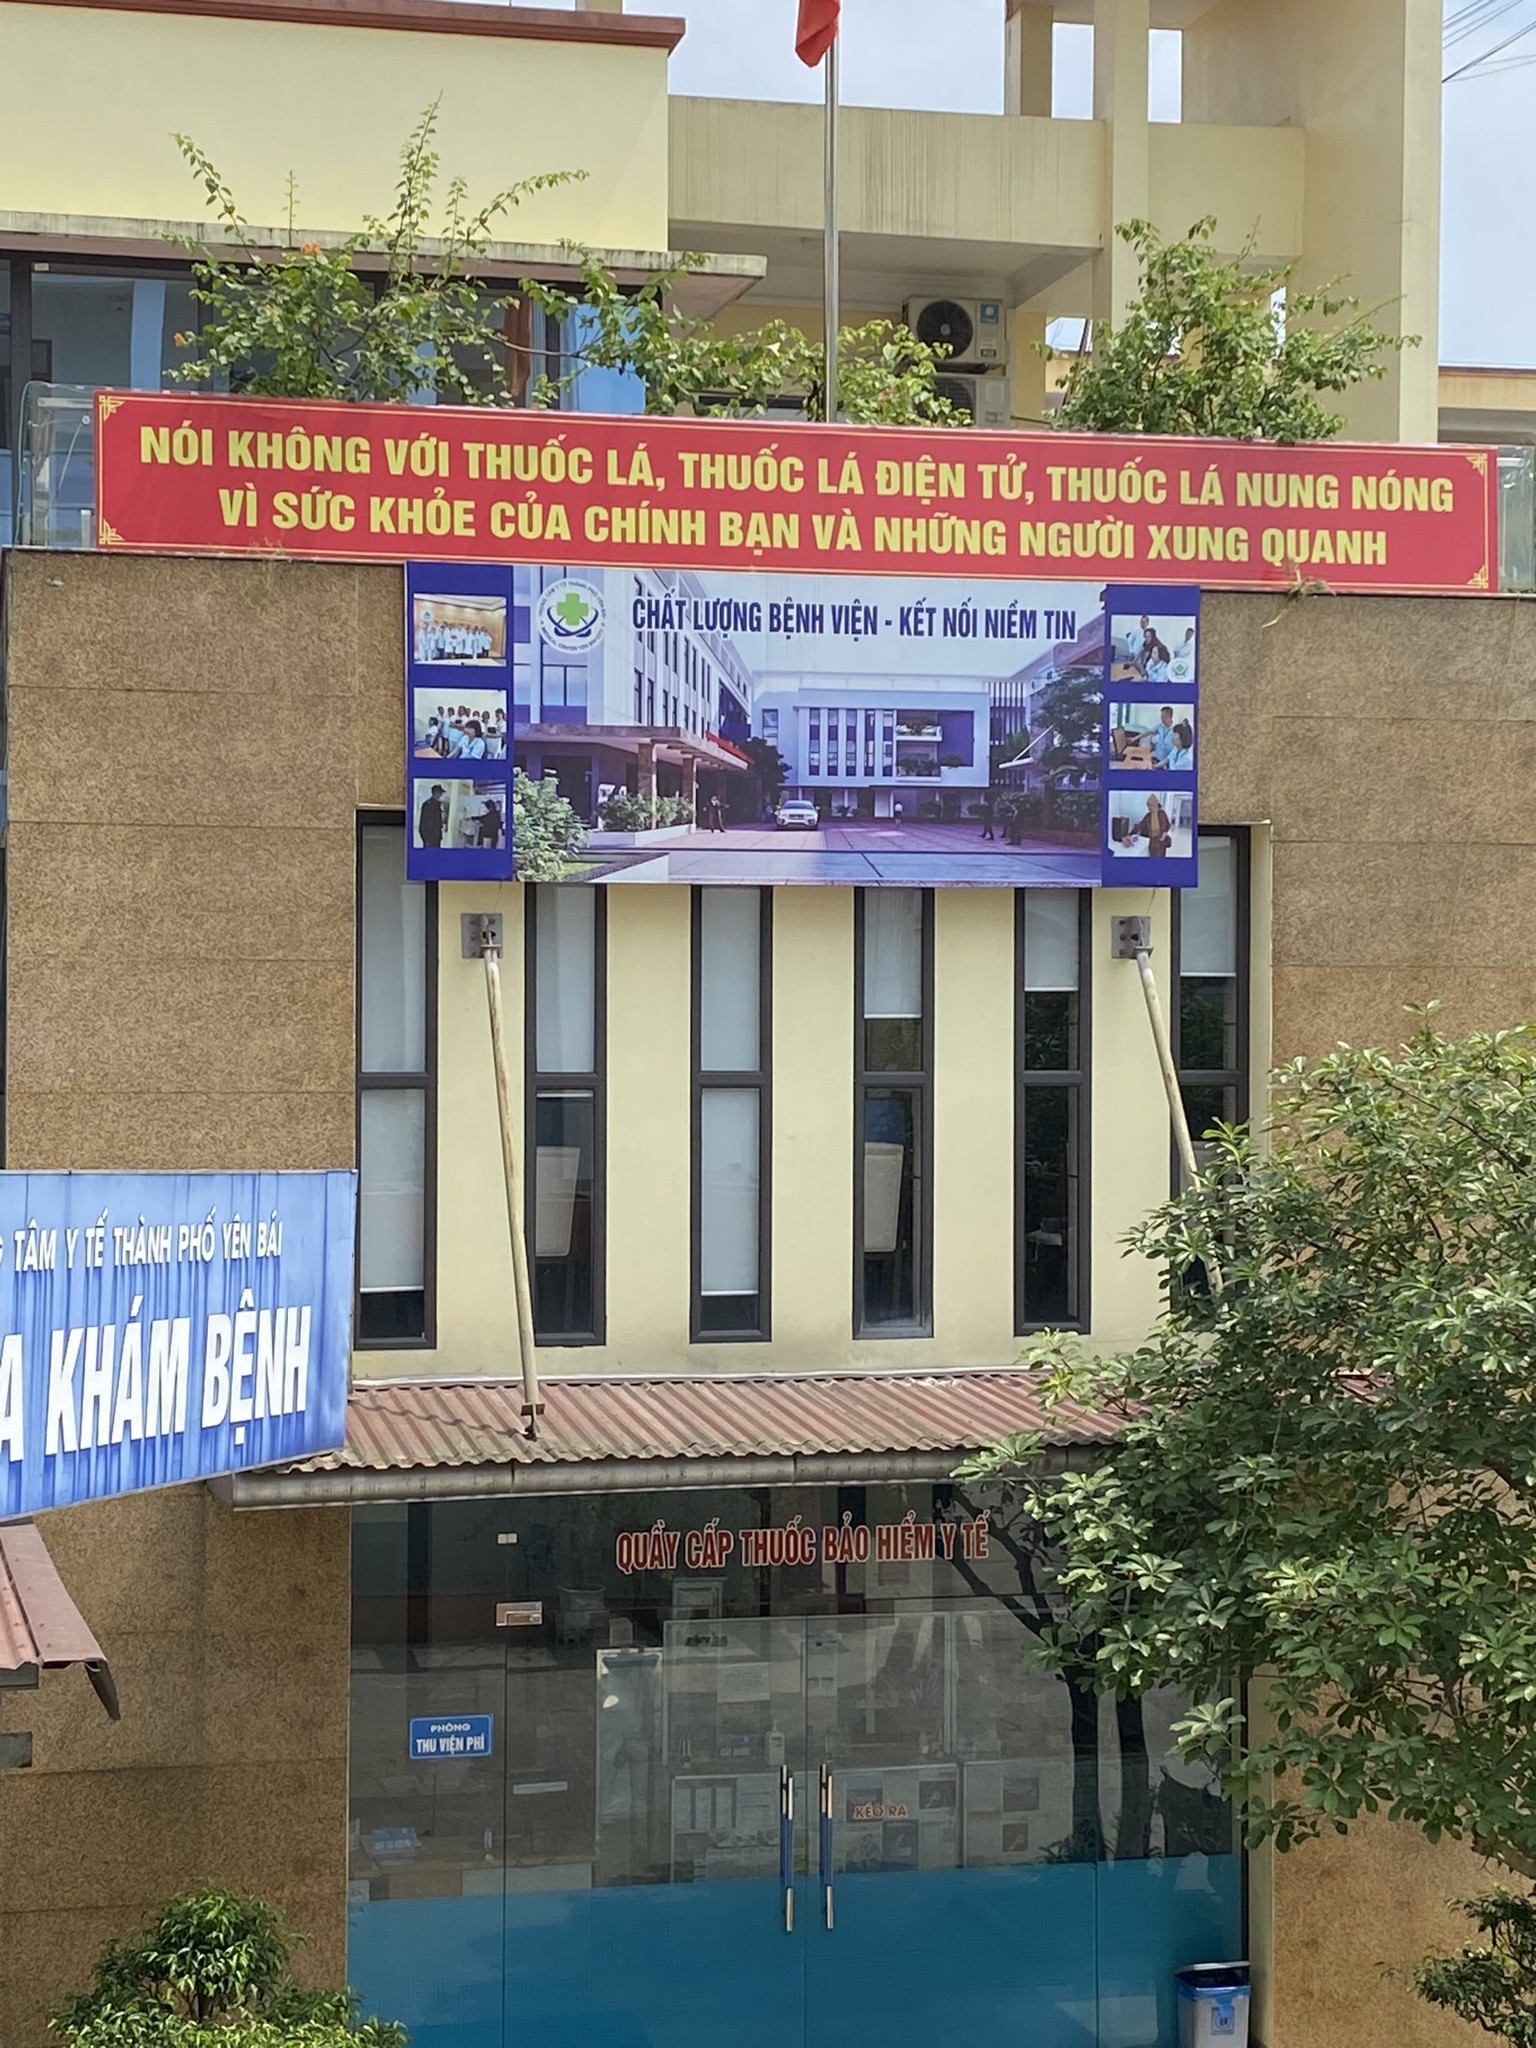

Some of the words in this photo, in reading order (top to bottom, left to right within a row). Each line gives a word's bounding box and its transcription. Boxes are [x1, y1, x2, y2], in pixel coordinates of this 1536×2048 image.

[140, 419, 213, 466] NÓI
[229, 426, 371, 474] KHÔNG
[384, 432, 450, 478] VỚI
[463, 434, 593, 485] THUỐC
[608, 442, 666, 491] LÁ,
[678, 443, 805, 495] THUỐC
[818, 451, 865, 496] LÁ
[874, 455, 966, 506] ĐIỆN
[977, 452, 1035, 505] TỬ,
[1046, 456, 1167, 505] THUỐC
[1180, 463, 1225, 506] LÁ
[1237, 472, 1339, 510] NUNG
[1351, 468, 1454, 513] NÓNG
[218, 482, 257, 527] VÌ
[272, 486, 355, 532] SỨC
[370, 486, 476, 537] KHỎE
[490, 490, 572, 541] CỦA
[585, 500, 706, 546] CHÍNH
[719, 511, 800, 556] BẠN
[811, 507, 862, 552] VÀ
[874, 511, 1007, 556] NHỮNG
[1019, 515, 1135, 559] NGƯỜI
[1147, 525, 1249, 562] XUNG
[1262, 528, 1387, 567] QUANH
[632, 588, 687, 631] CHẤT
[693, 596, 762, 639] LƯỢNG
[769, 597, 825, 641] BỆNH
[831, 598, 878, 642] VIỆN
[899, 597, 937, 637] KẾT
[943, 597, 978, 639] NỐI
[985, 599, 1038, 640] NIỀM
[1043, 610, 1077, 641] TIN
[14, 1218, 58, 1272] TÂM
[66, 1227, 80, 1270] Y
[85, 1208, 108, 1268] TẾ
[113, 1214, 173, 1267] THÀNH
[178, 1206, 217, 1263] PHỐ
[222, 1212, 251, 1260] YÊN
[256, 1210, 284, 1258] BÁI
[45, 1294, 191, 1456] KHÁM
[201, 1287, 311, 1446] BỆNH
[616, 1519, 680, 1575] QUẦY
[684, 1517, 734, 1569] CẤP
[740, 1515, 816, 1567] THUỐC
[822, 1511, 869, 1564] BẢO
[875, 1510, 935, 1562] HIỂM
[941, 1522, 957, 1560] Y
[961, 1509, 991, 1559] TẾ
[416, 1738, 437, 1753] THU
[439, 1734, 464, 1755] VIỆN
[466, 1732, 485, 1751] PHÍ
[887, 1803, 908, 1819] RA
